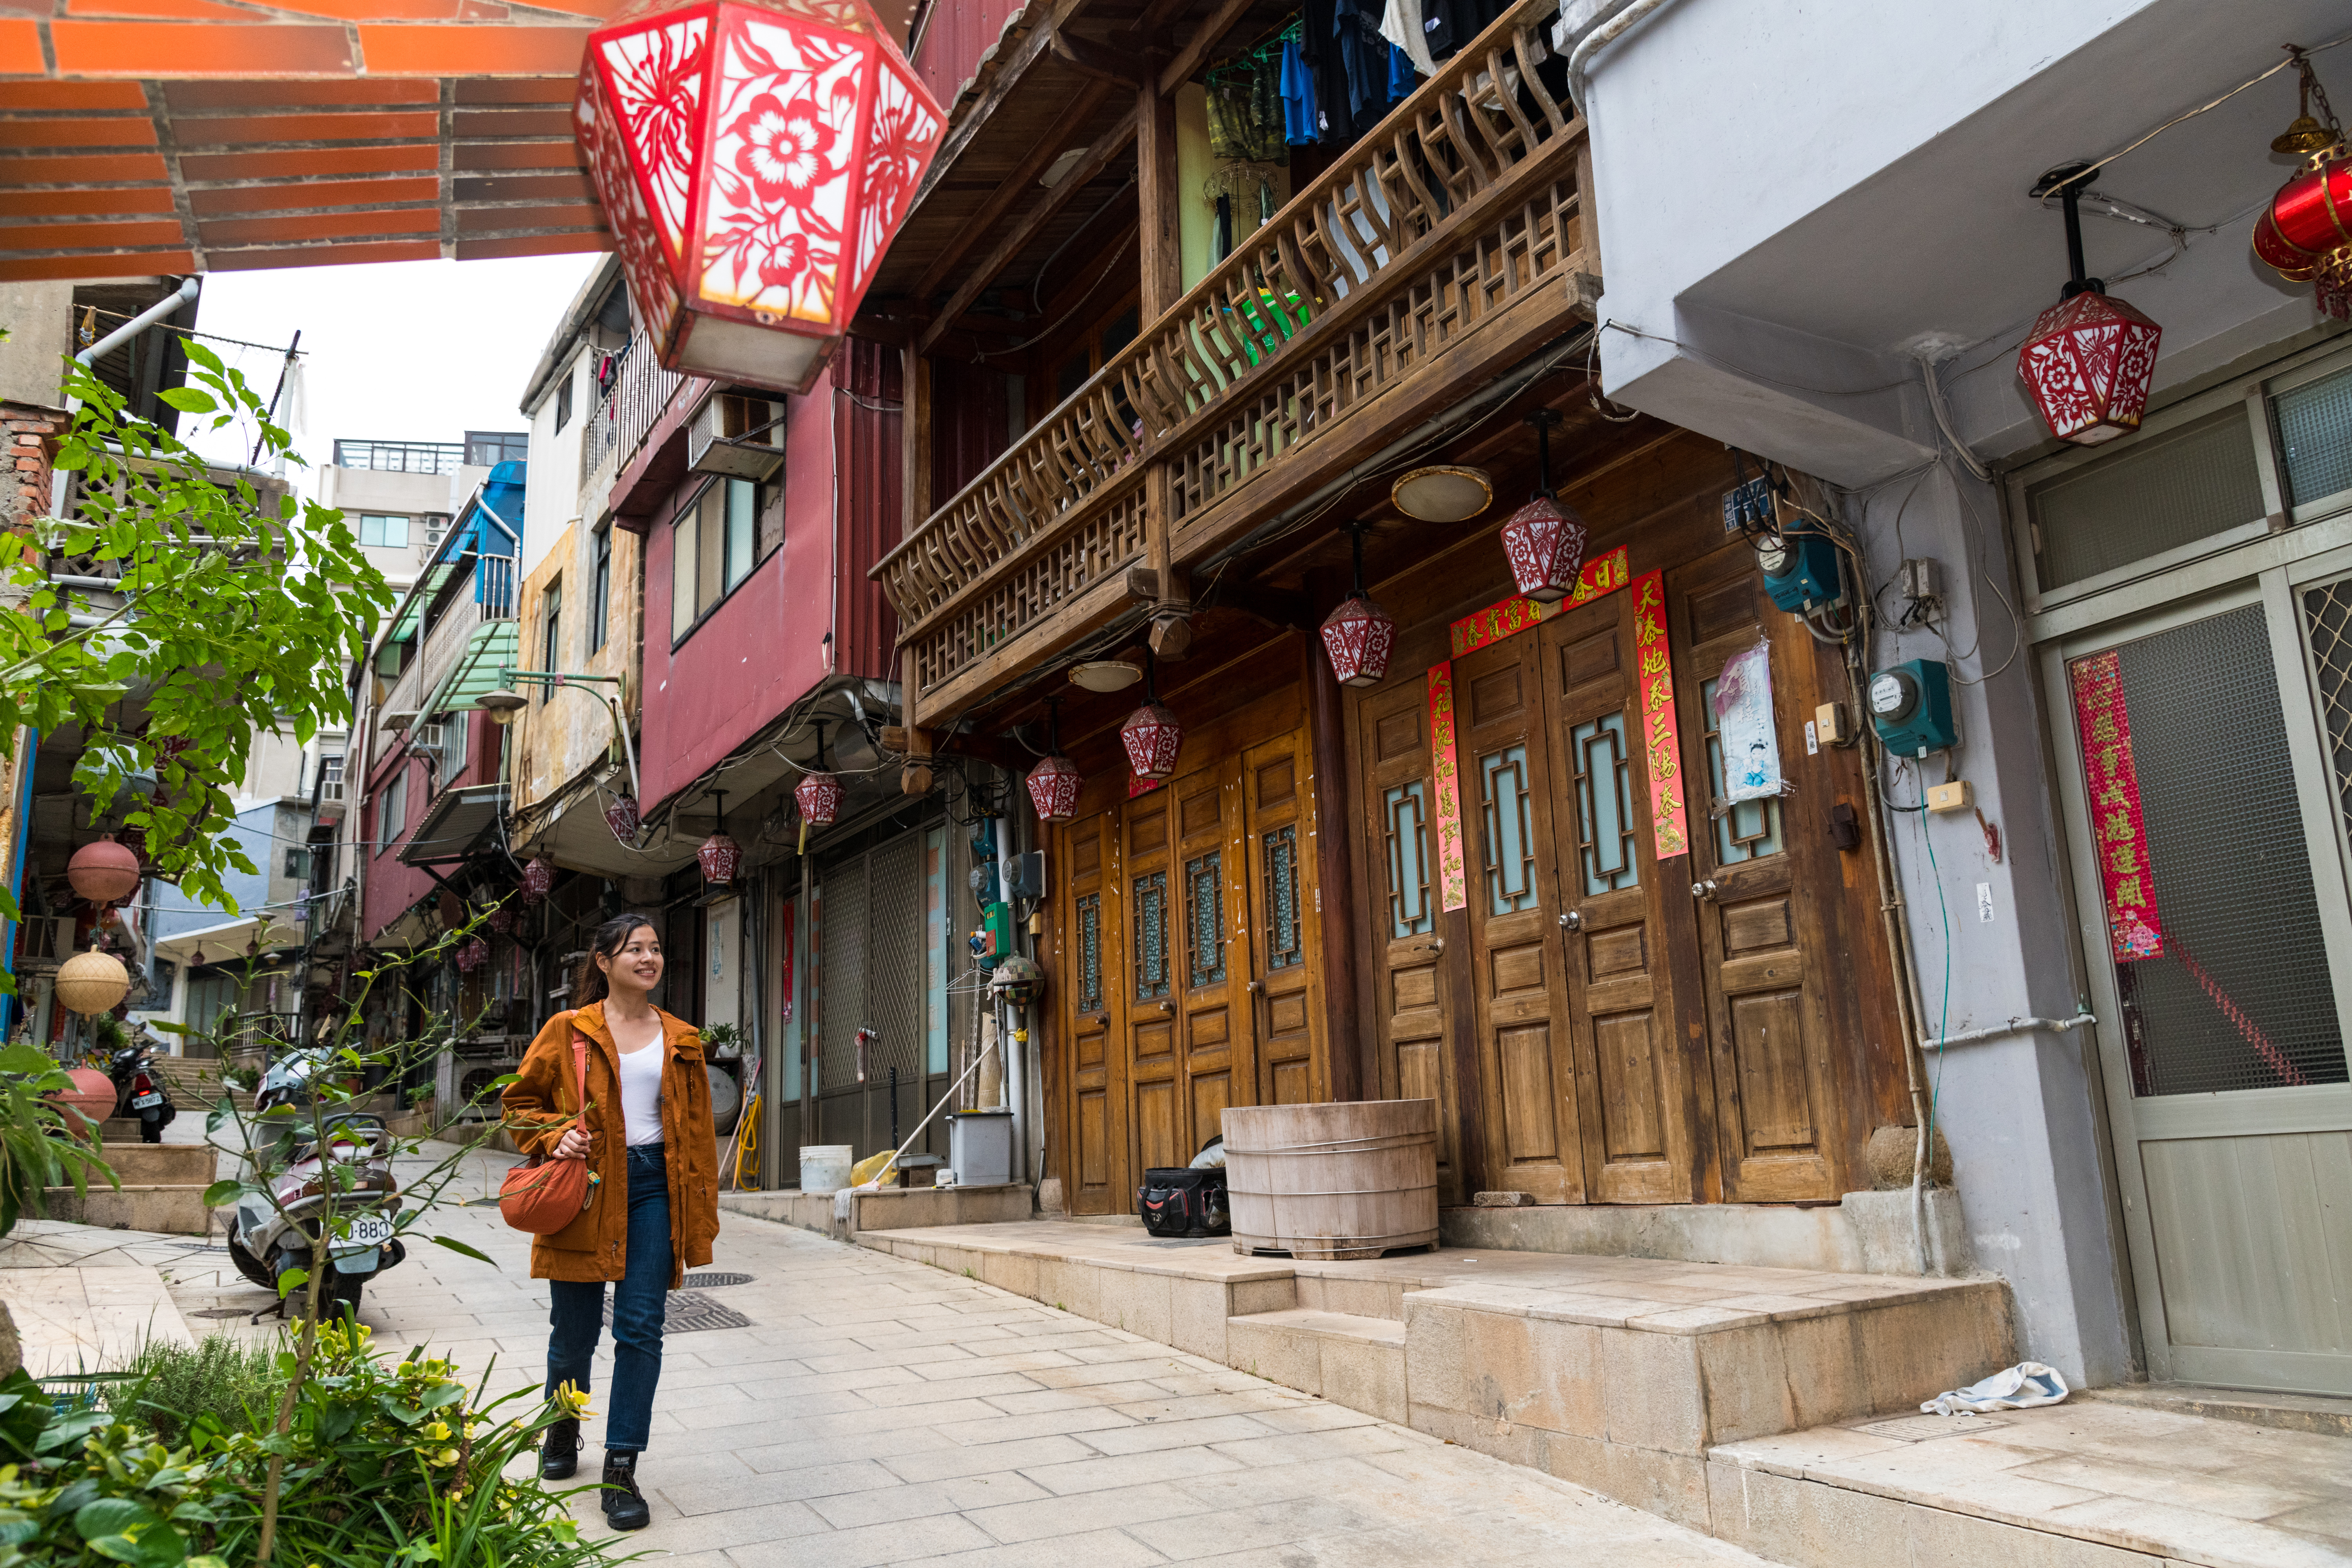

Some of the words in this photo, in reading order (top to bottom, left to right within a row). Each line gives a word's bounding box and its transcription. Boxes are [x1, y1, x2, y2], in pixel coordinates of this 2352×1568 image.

[1431, 671, 1461, 877] 人和家和萬事和
[1639, 579, 1682, 819] 天泰地泰三陽泰
[2087, 683, 2147, 908] 心想事成鴻運開
